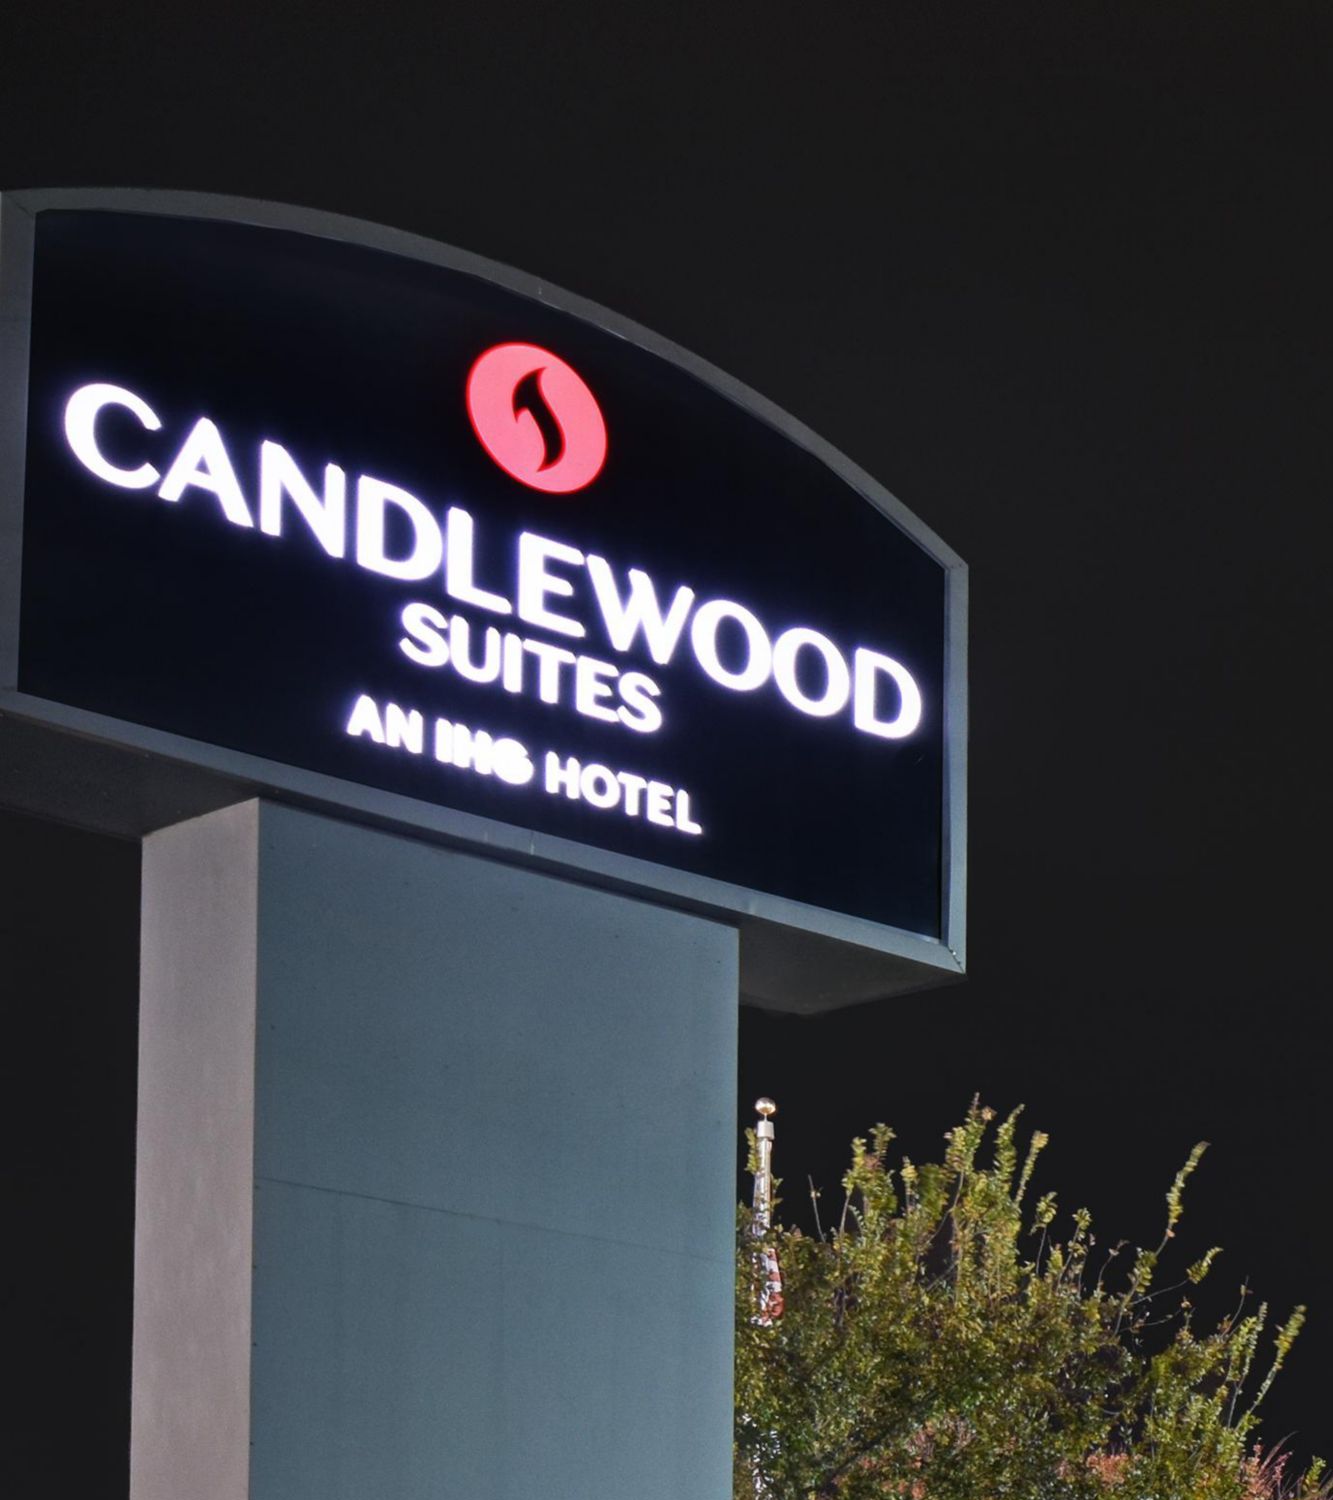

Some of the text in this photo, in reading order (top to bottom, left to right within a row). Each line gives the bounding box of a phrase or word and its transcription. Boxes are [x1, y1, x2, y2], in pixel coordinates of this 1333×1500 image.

[64, 383, 923, 740] CANDLEWOOD
[399, 602, 663, 733] SUITES
[346, 694, 703, 835] AN IHG HOTEL
